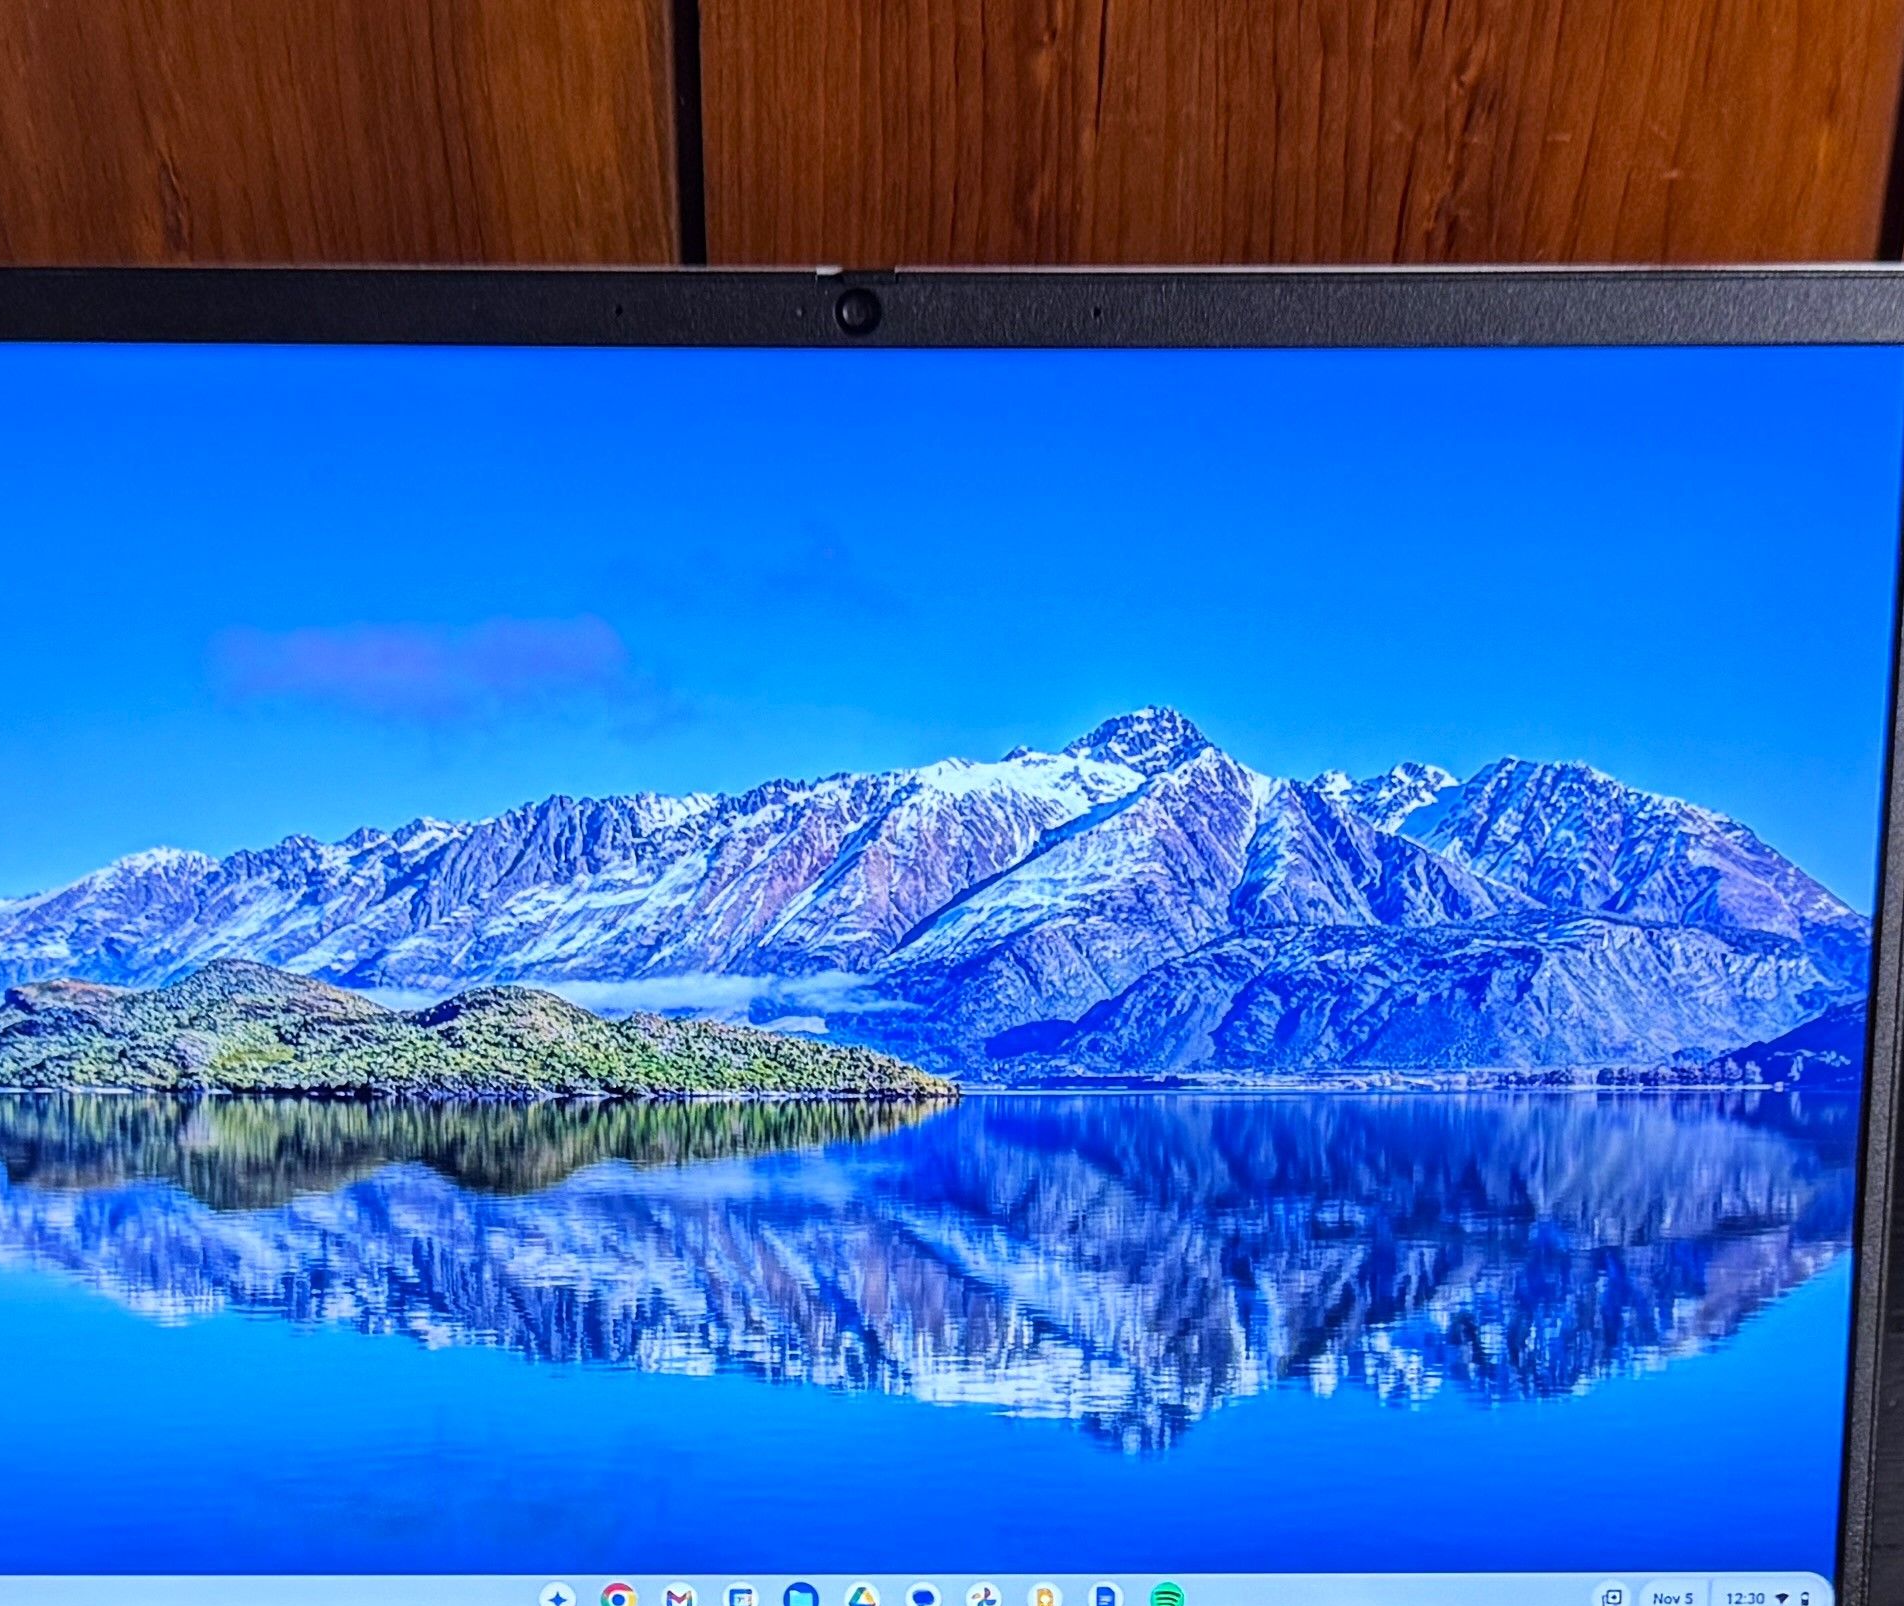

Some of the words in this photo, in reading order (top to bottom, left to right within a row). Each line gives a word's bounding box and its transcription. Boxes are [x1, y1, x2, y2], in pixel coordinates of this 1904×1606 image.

[1652, 1592, 1681, 1605] Nov
[1684, 1592, 1694, 1605] 5
[1726, 1592, 1765, 1605] 12:30
